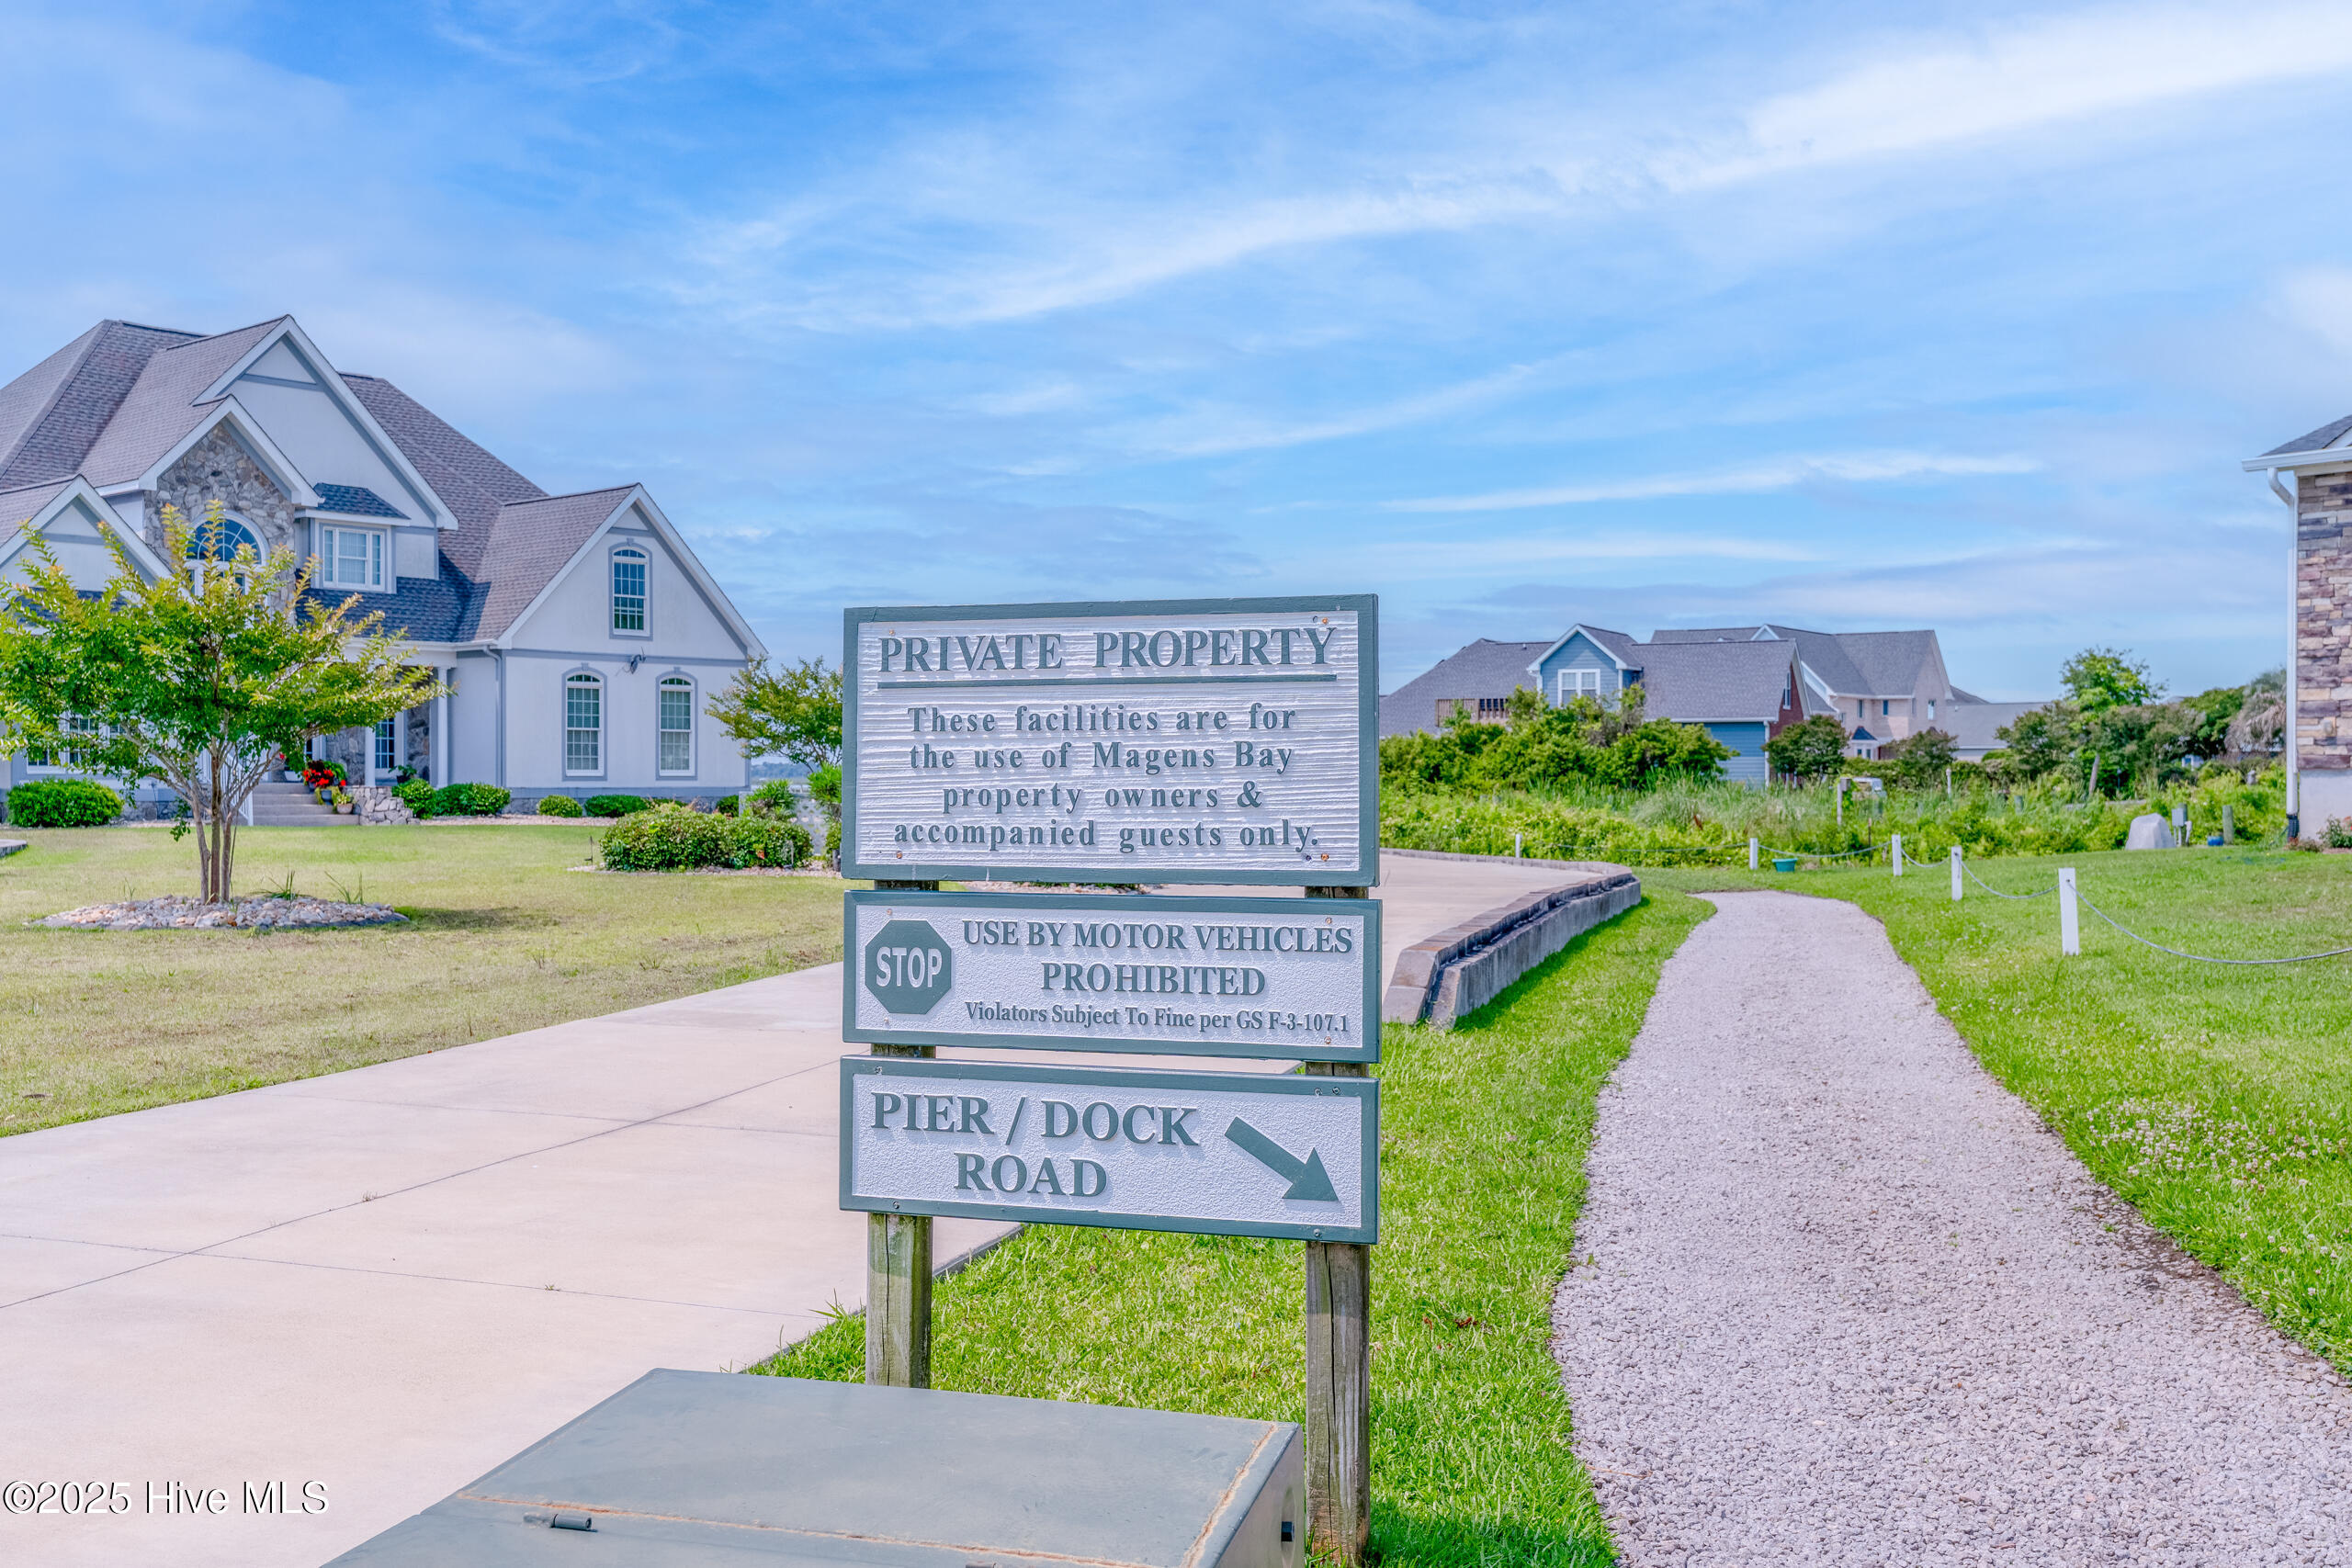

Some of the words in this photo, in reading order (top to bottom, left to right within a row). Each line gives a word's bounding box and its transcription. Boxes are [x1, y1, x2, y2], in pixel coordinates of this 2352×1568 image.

[878, 633, 1062, 672] PRIVATE
[1093, 626, 1337, 669] PROPERTY
[908, 706, 996, 733] These
[1015, 704, 1159, 731] facilities
[1176, 709, 1228, 729] are
[1249, 702, 1295, 729] for
[910, 743, 955, 769] the
[974, 749, 1023, 768] use
[1042, 742, 1072, 768] of
[1092, 742, 1215, 774] Magens
[1235, 740, 1293, 773] Bay
[943, 783, 1082, 814] property
[1105, 786, 1218, 807] owners
[1237, 780, 1262, 807] &
[895, 819, 1095, 851] accompanied
[1119, 824, 1221, 852] guests
[1240, 818, 1318, 852] only.
[962, 920, 1019, 946] USE
[1028, 922, 1066, 947] BY
[1073, 922, 1187, 951] MOTOR
[1194, 925, 1353, 953] VEHICLES
[876, 947, 943, 988] STOP
[1041, 962, 1266, 996] PROHIBITED
[966, 1001, 1047, 1022] Violators
[1052, 1004, 1119, 1026] Subject
[1125, 1007, 1148, 1025] To
[1154, 1008, 1194, 1027] Fine
[1199, 1013, 1233, 1032] per
[1237, 1010, 1262, 1029] GS
[1269, 1010, 1348, 1032] F-3-107.1
[870, 1092, 994, 1135] PIER
[1006, 1097, 1026, 1145] /
[1041, 1100, 1198, 1146] DOCK
[955, 1152, 1107, 1197] ROAD
